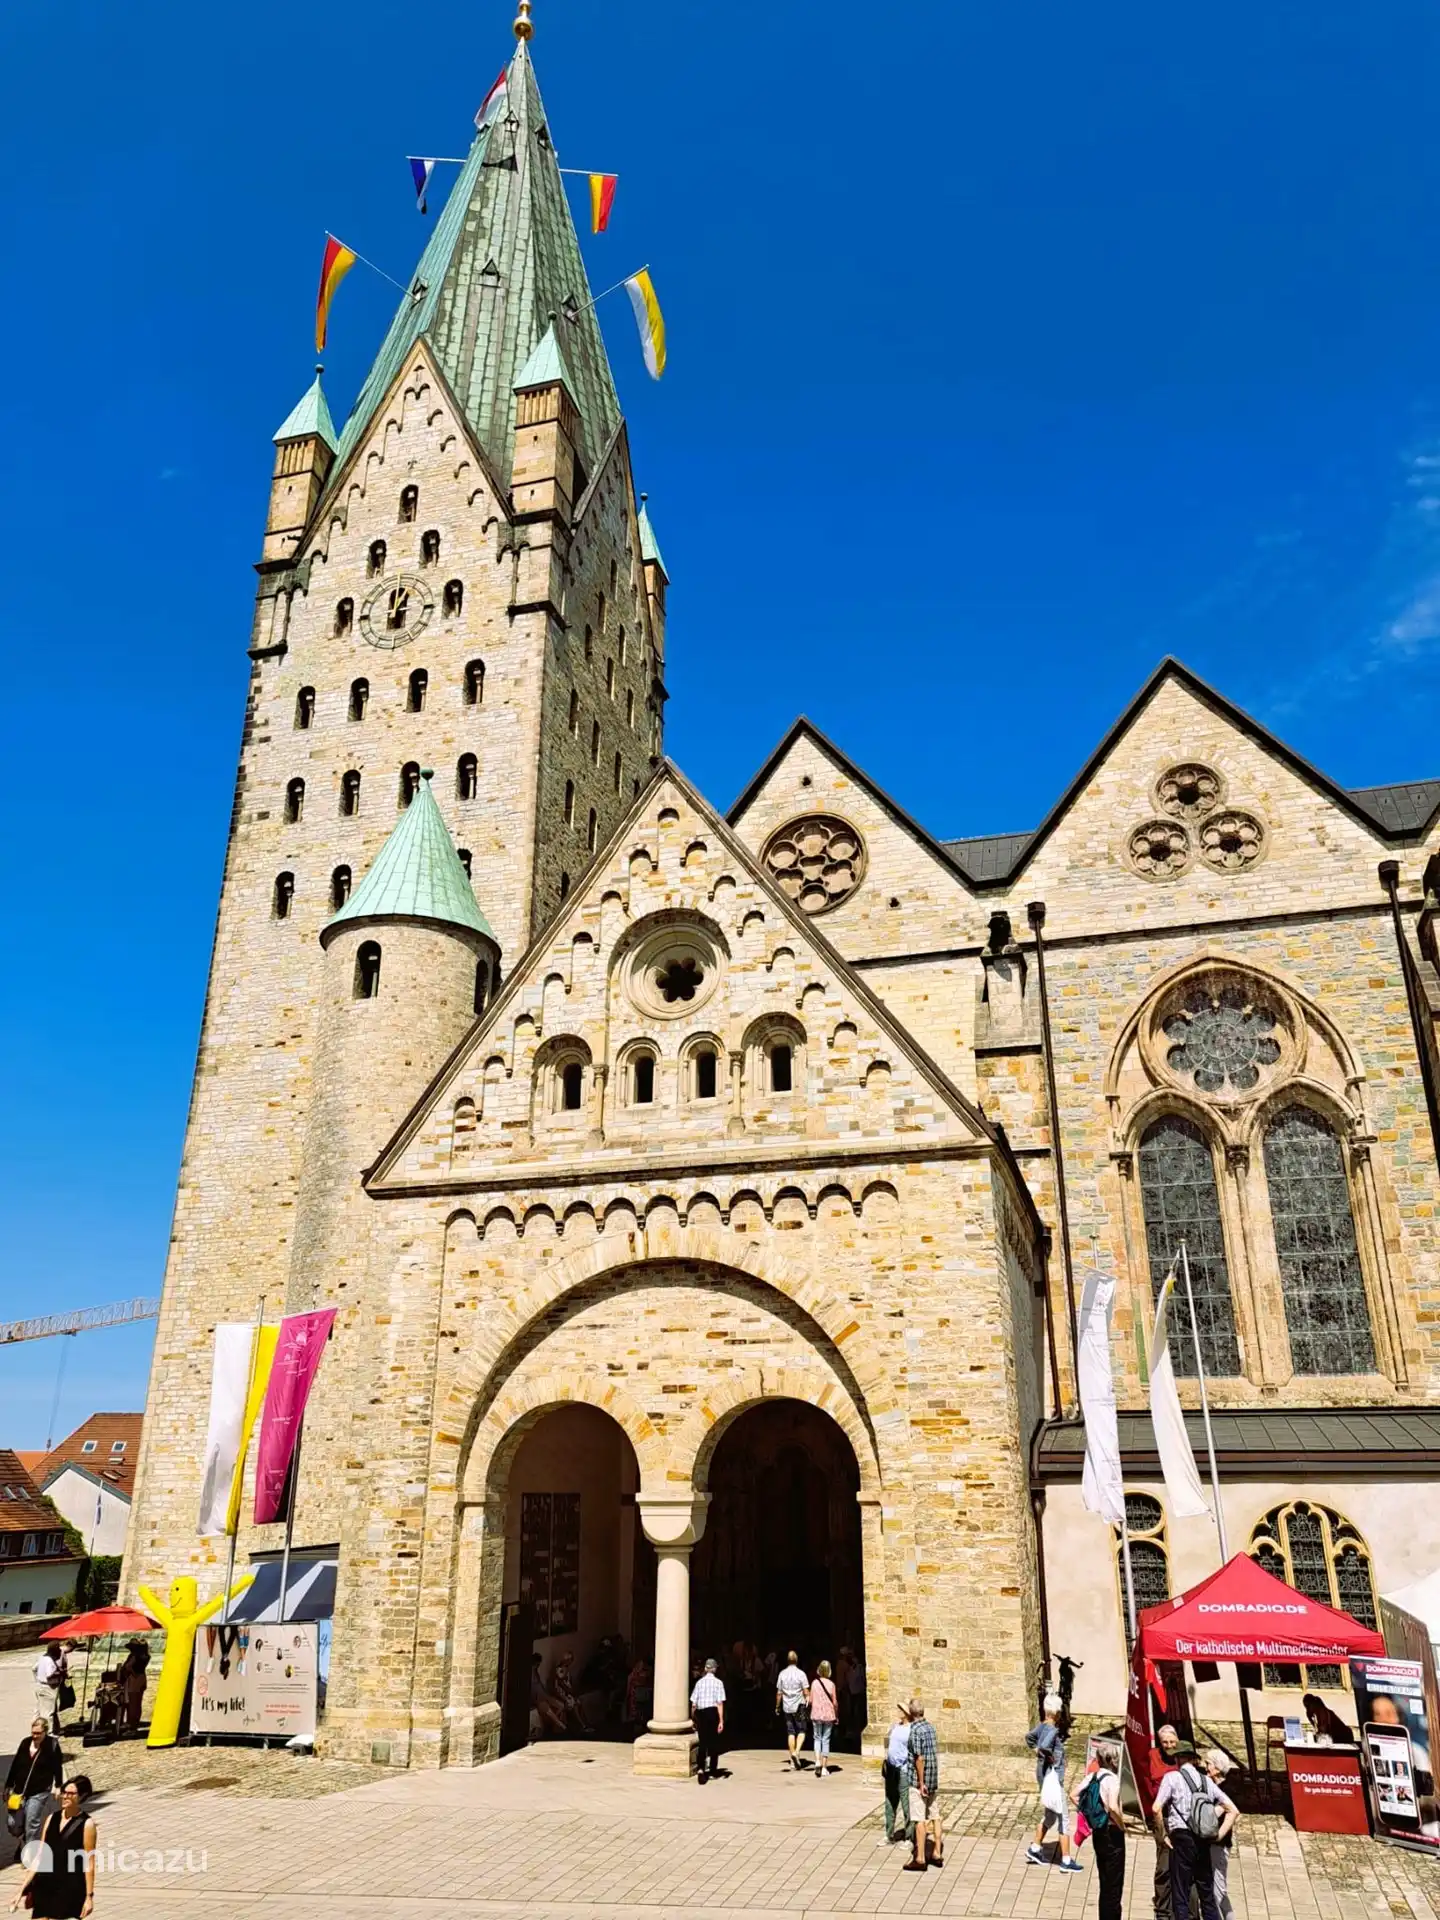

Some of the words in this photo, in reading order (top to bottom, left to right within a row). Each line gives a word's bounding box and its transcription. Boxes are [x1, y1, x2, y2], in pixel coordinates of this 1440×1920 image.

[1198, 1603, 1308, 1614] DOMRADIO.DE
[1175, 1639, 1194, 1654] Der
[1196, 1640, 1254, 1656] katholische
[1256, 1640, 1349, 1657] Multimediasender
[201, 1697, 214, 1711] It's
[217, 1700, 228, 1715] my
[230, 1696, 246, 1711] life!
[1292, 1773, 1362, 1785] DOMRADIO.DE
